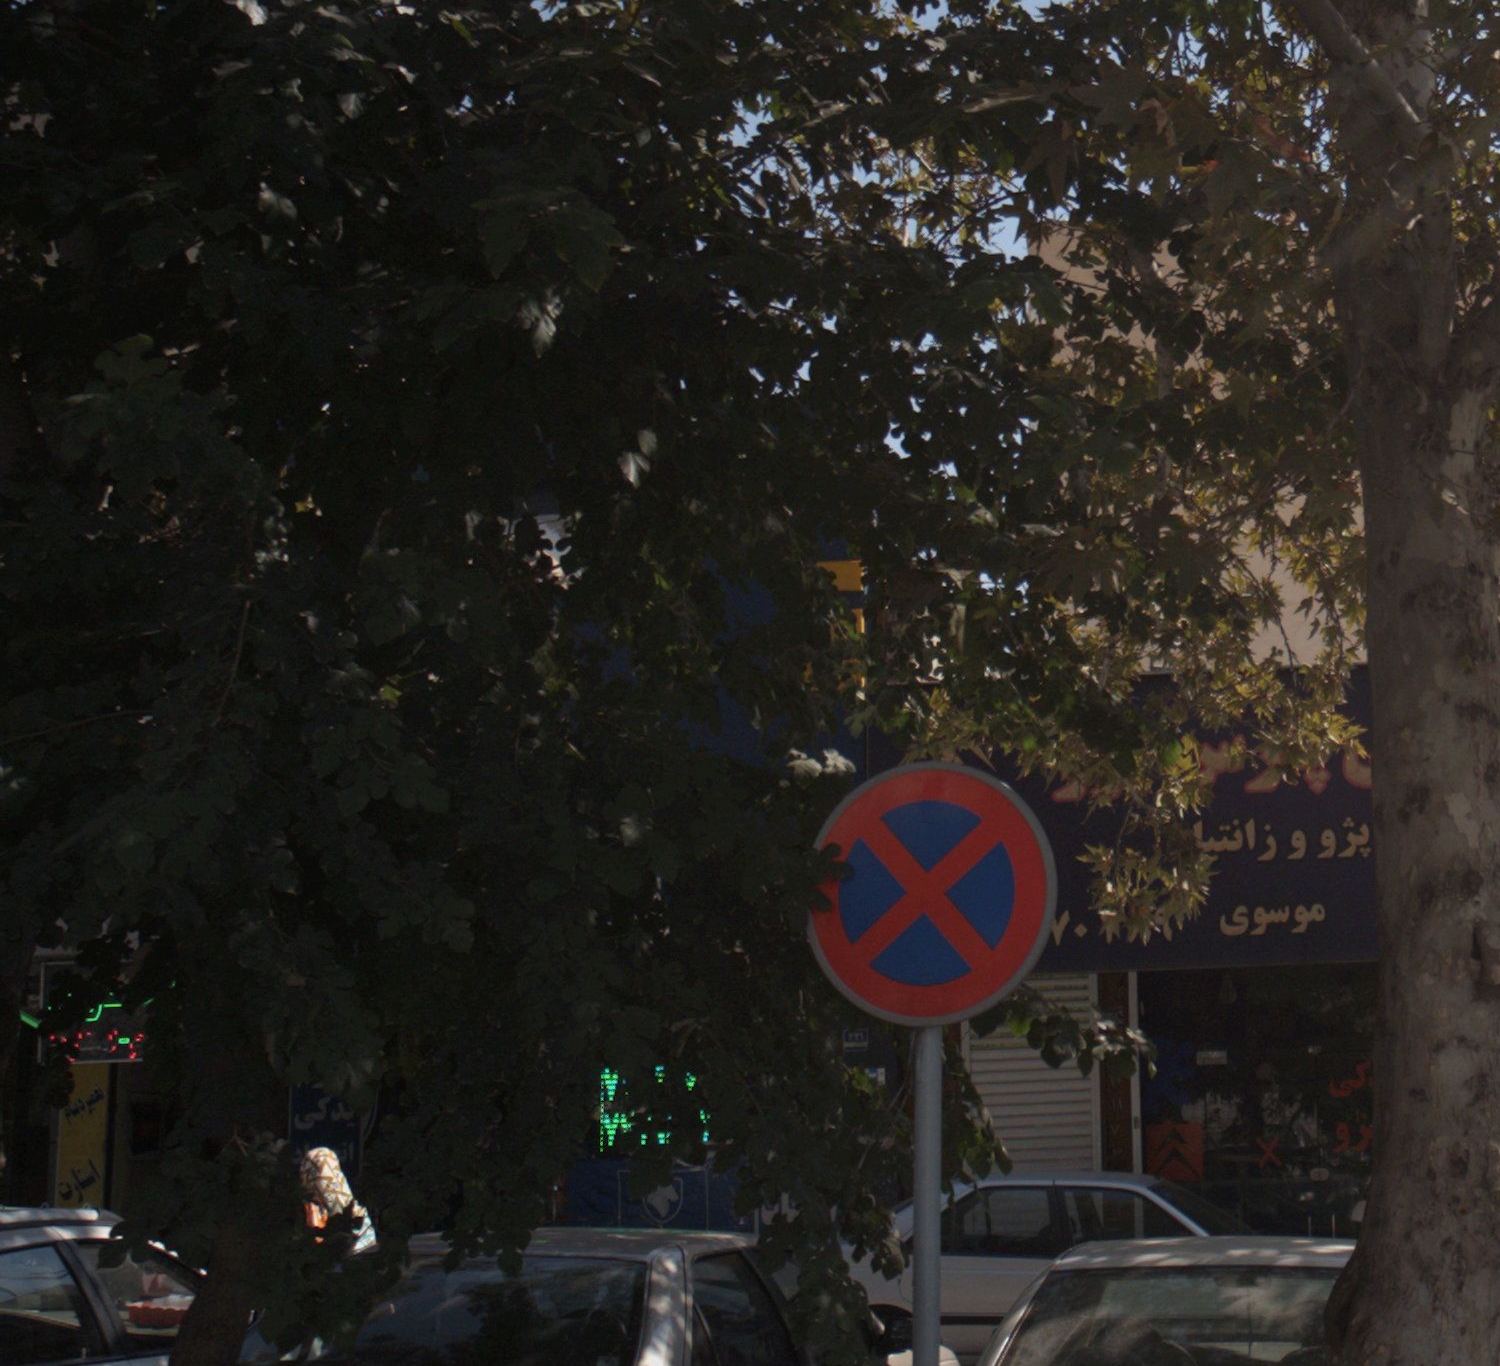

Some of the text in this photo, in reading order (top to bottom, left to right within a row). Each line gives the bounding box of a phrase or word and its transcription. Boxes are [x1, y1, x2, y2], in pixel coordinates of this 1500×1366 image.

[1287, 828, 1307, 860] و
[1317, 816, 1373, 858] پژو
[1219, 903, 1327, 936] موسوی
